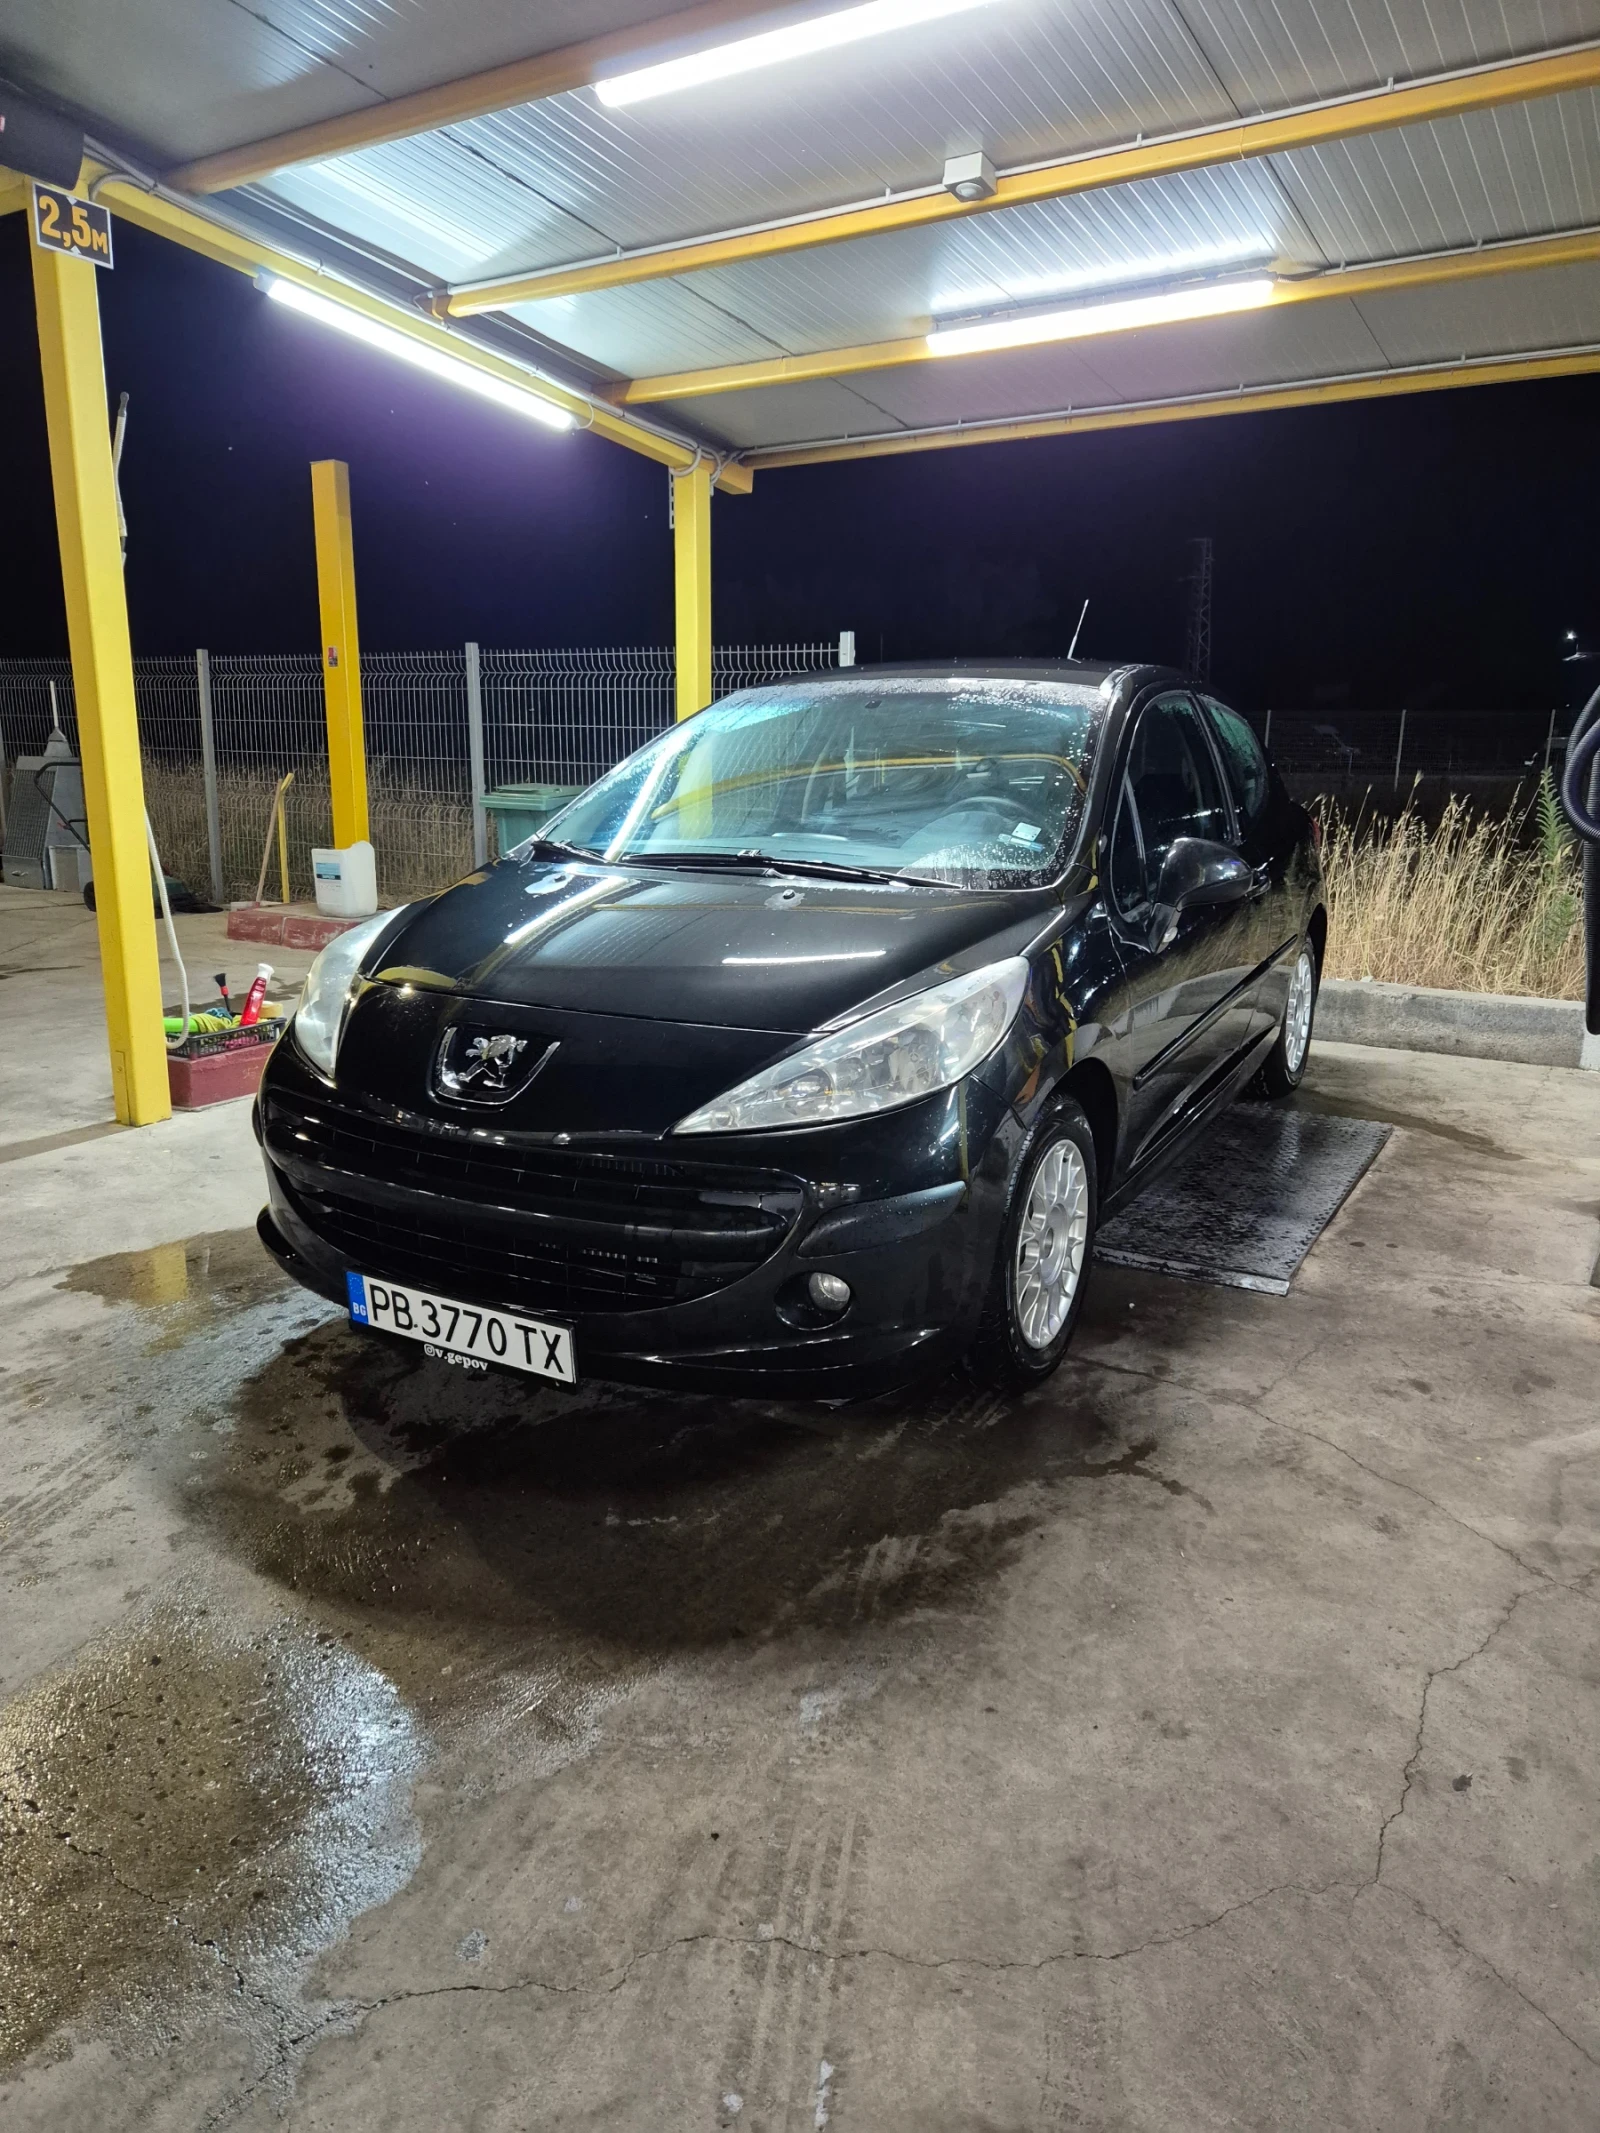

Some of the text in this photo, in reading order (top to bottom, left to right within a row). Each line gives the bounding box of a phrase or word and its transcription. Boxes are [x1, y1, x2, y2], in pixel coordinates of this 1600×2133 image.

[352, 1301, 367, 1316] BG
[369, 1283, 565, 1374] PB 3770 TX
